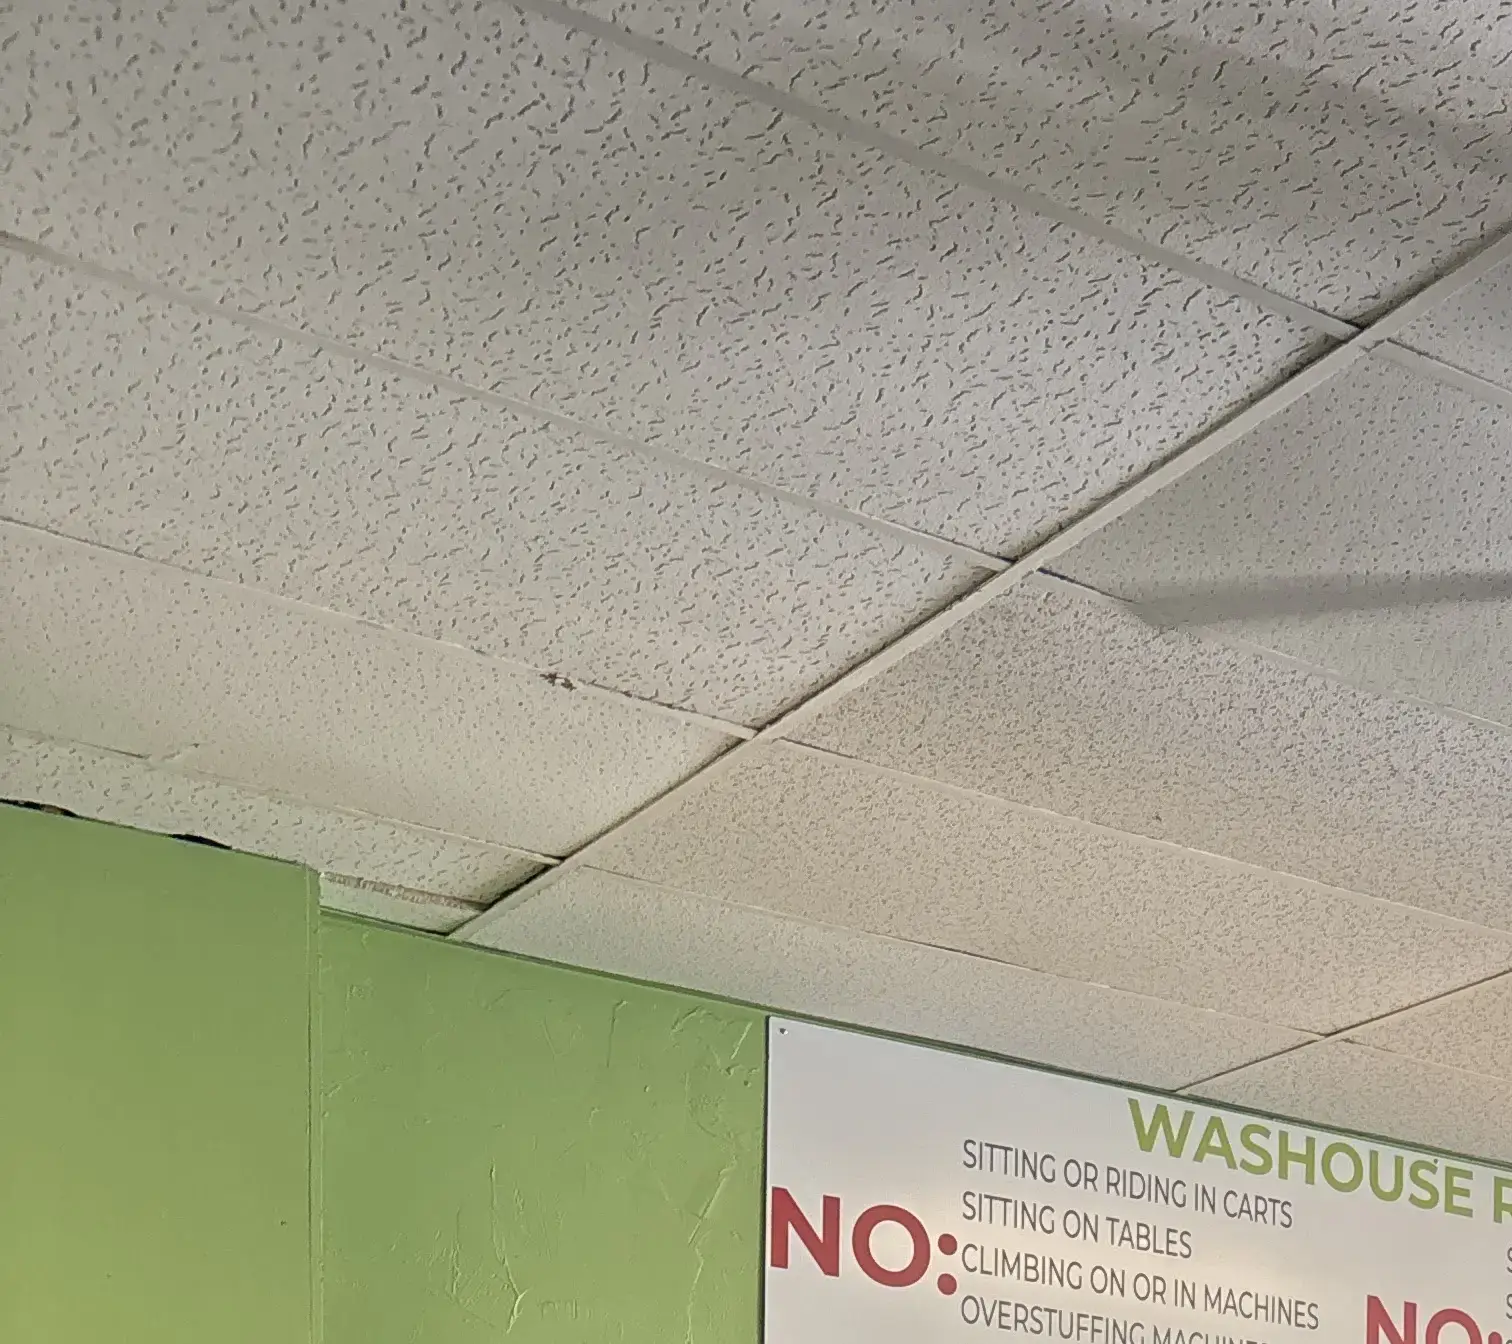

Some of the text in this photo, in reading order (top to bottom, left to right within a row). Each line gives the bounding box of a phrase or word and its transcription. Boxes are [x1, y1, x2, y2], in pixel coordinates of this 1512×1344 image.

[962, 1138, 1293, 1229] SITTING OR RIDING IN CARTS
[1127, 1097, 1474, 1219] WASHOUSE
[770, 1186, 958, 1296] NO:
[962, 1190, 1193, 1259] SITTING ON TABLES
[961, 1243, 1319, 1331] CLIMBING ON OR IN MACHINES
